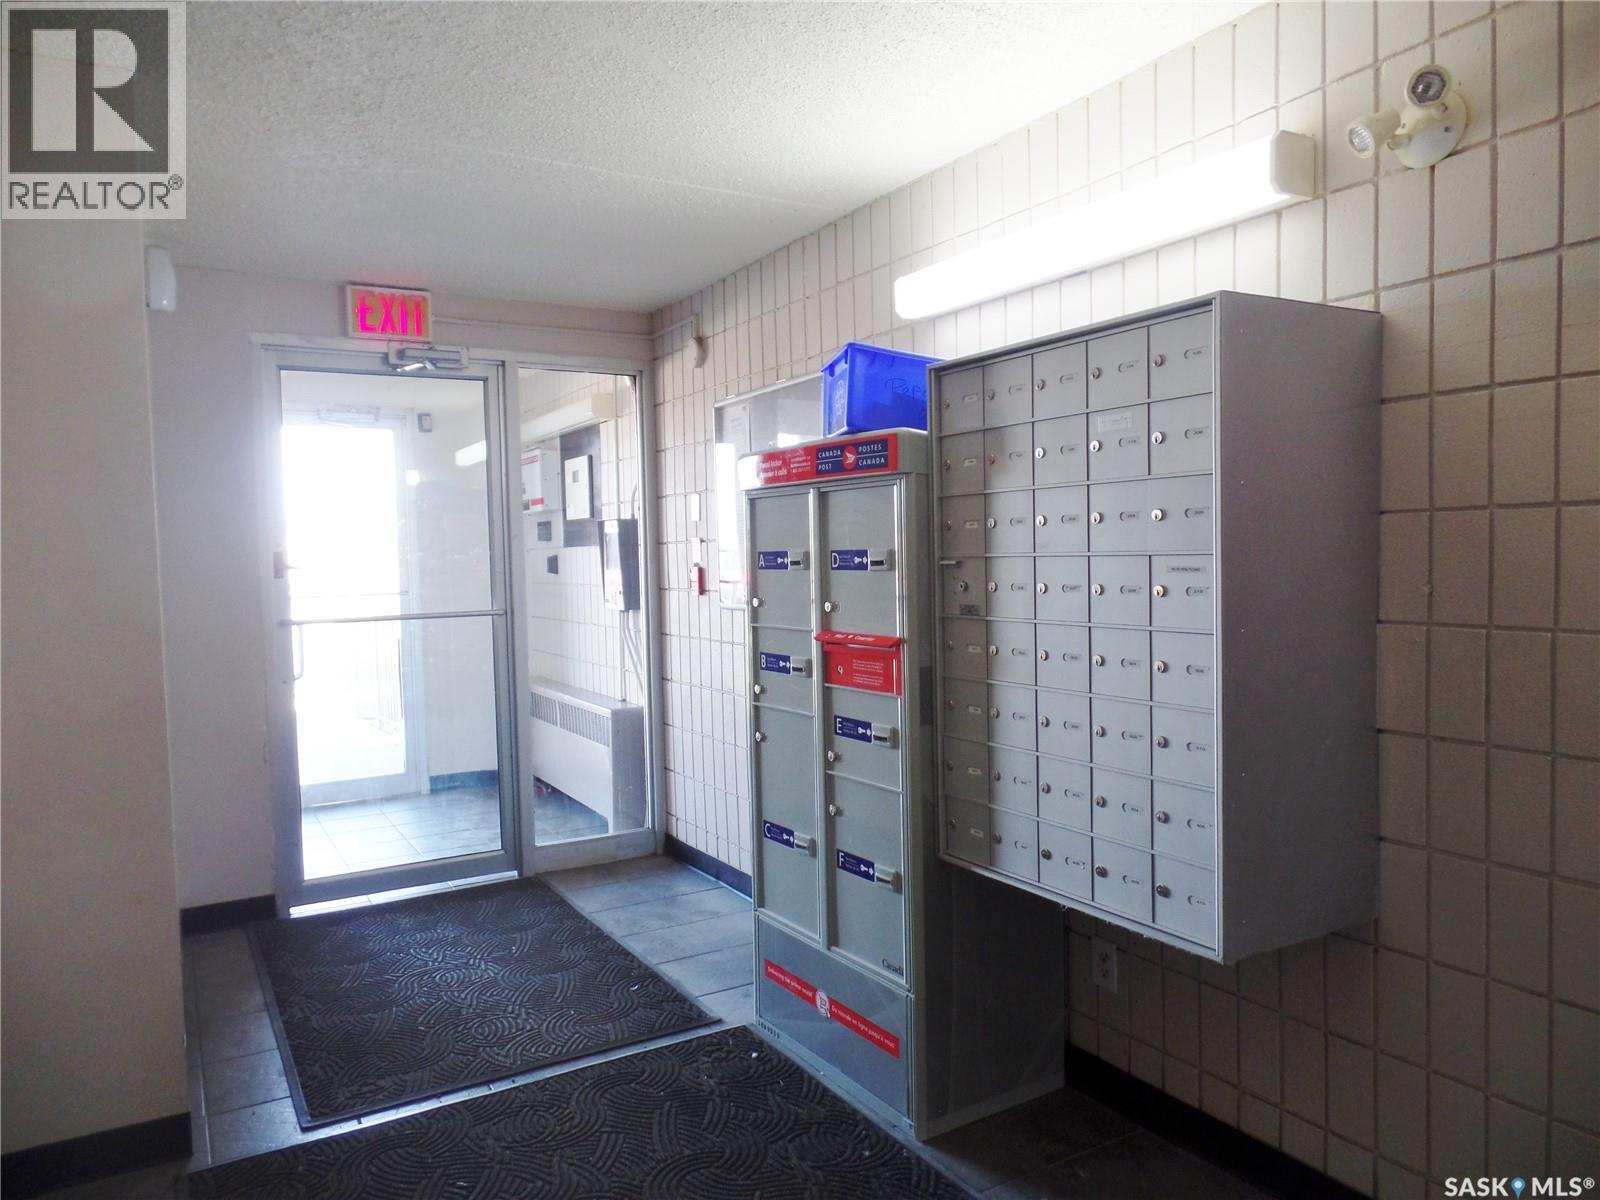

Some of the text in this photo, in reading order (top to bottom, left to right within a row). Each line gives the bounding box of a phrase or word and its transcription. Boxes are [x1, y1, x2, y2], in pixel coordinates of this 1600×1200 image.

[356, 290, 426, 337] EXIT
[818, 449, 842, 458] CANADA
[858, 444, 882, 452] POSTES
[818, 463, 832, 471] POST
[858, 457, 885, 466] CANADA
[758, 554, 765, 568] A
[832, 552, 839, 568] D
[761, 654, 766, 668] B
[837, 718, 842, 733] E
[764, 823, 771, 838] C
[839, 851, 845, 867] F
